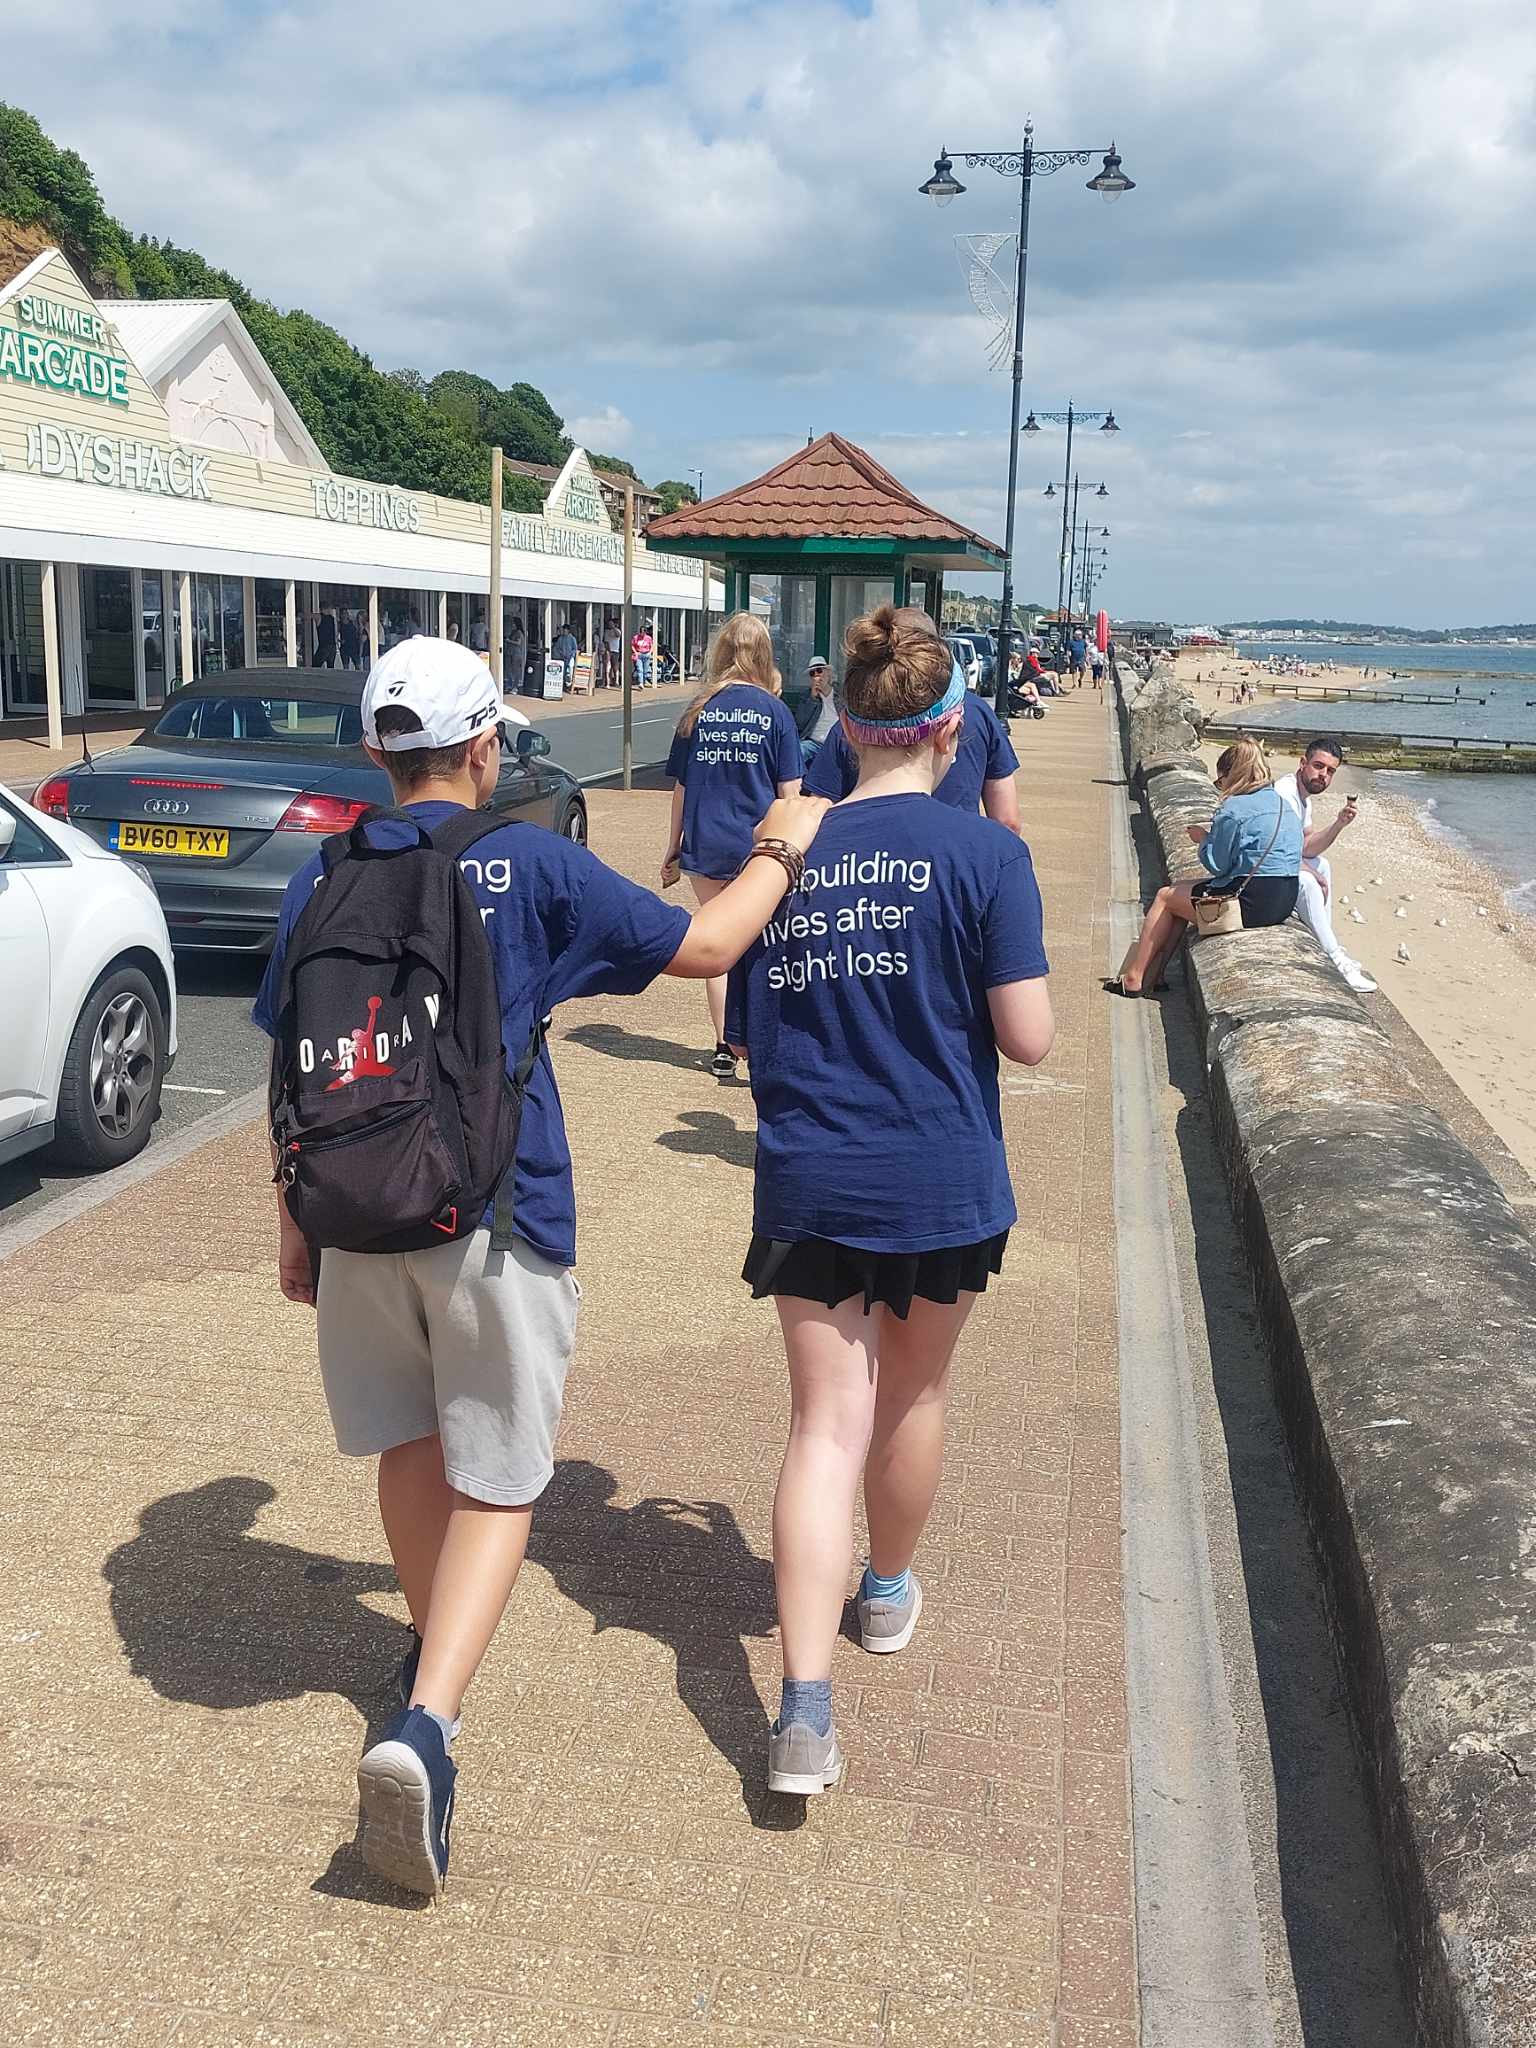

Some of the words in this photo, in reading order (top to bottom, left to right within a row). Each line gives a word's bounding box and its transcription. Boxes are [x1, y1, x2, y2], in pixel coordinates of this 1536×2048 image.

[20, 295, 104, 342] SUMMER
[0, 328, 129, 403] ARCADE
[311, 479, 420, 533] TOPPINGS
[565, 493, 600, 521] ARCADE
[501, 512, 551, 553] FAMILY
[697, 707, 772, 731] Rebuilding
[698, 728, 729, 743] lives
[730, 728, 766, 745] after
[696, 747, 732, 765] sight
[735, 747, 759, 764] loss
[124, 826, 178, 850] BV60
[185, 830, 225, 853] TXY
[788, 851, 931, 893] building
[836, 898, 915, 933] after
[767, 949, 839, 992] sight
[847, 944, 909, 977] loss
